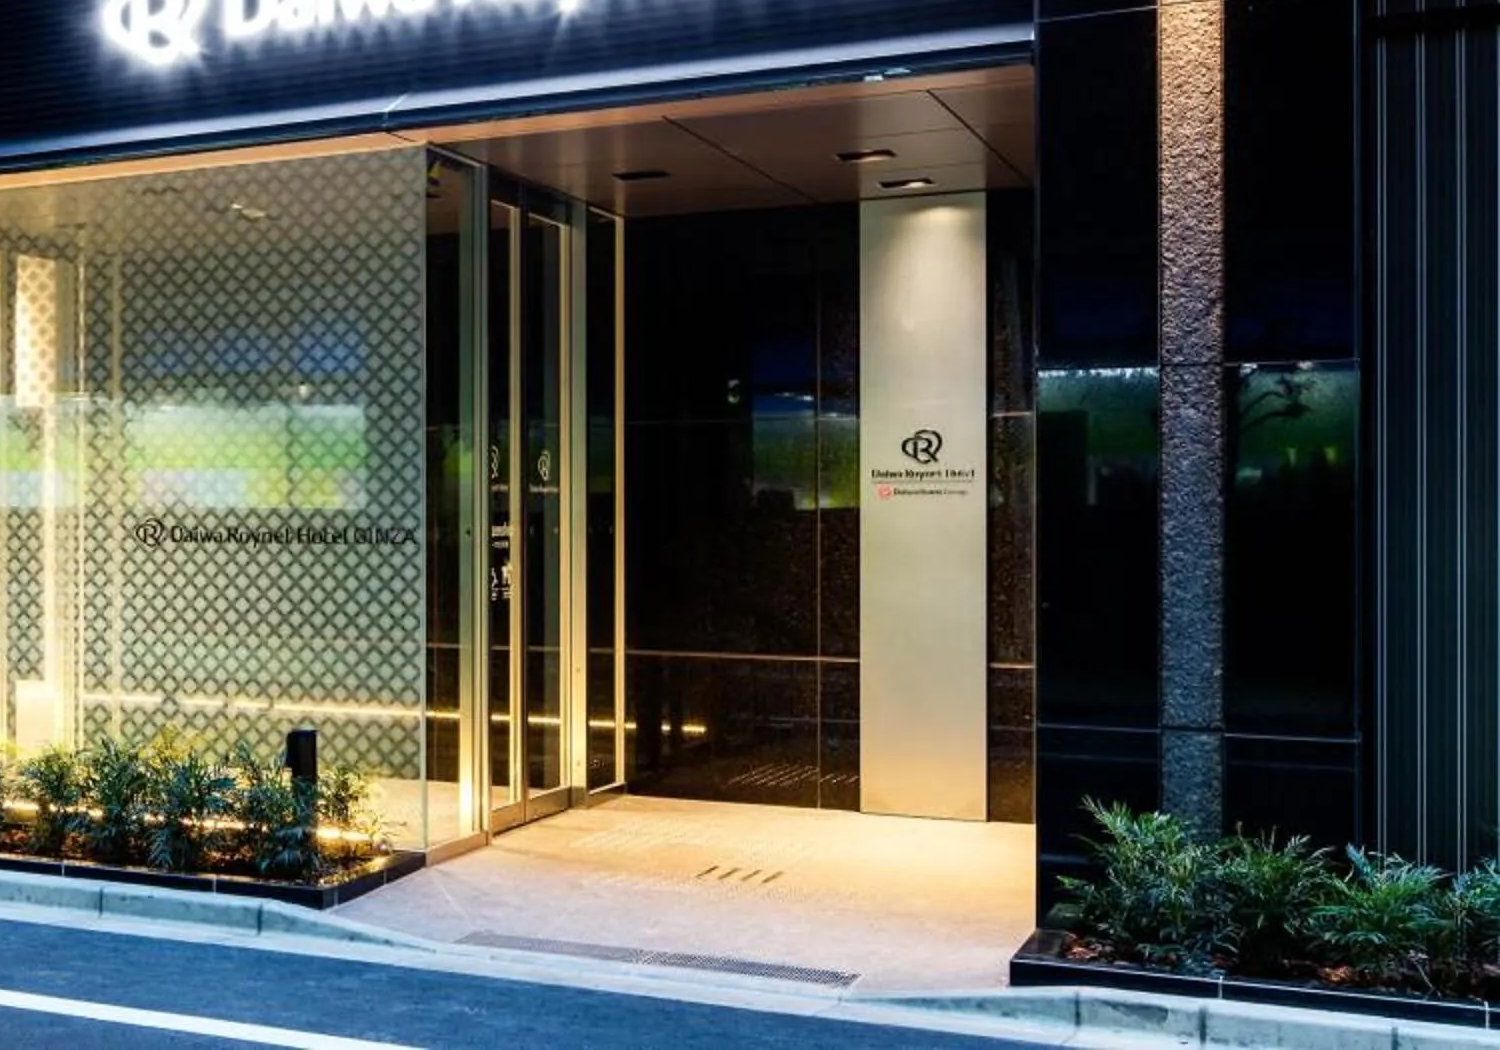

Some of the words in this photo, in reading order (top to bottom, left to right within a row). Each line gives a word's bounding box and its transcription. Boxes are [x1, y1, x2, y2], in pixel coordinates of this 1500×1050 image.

[171, 526, 223, 543] Daiwa
[227, 526, 291, 548] Roynet
[297, 527, 347, 544] Hotel
[354, 527, 417, 544] GINZA
